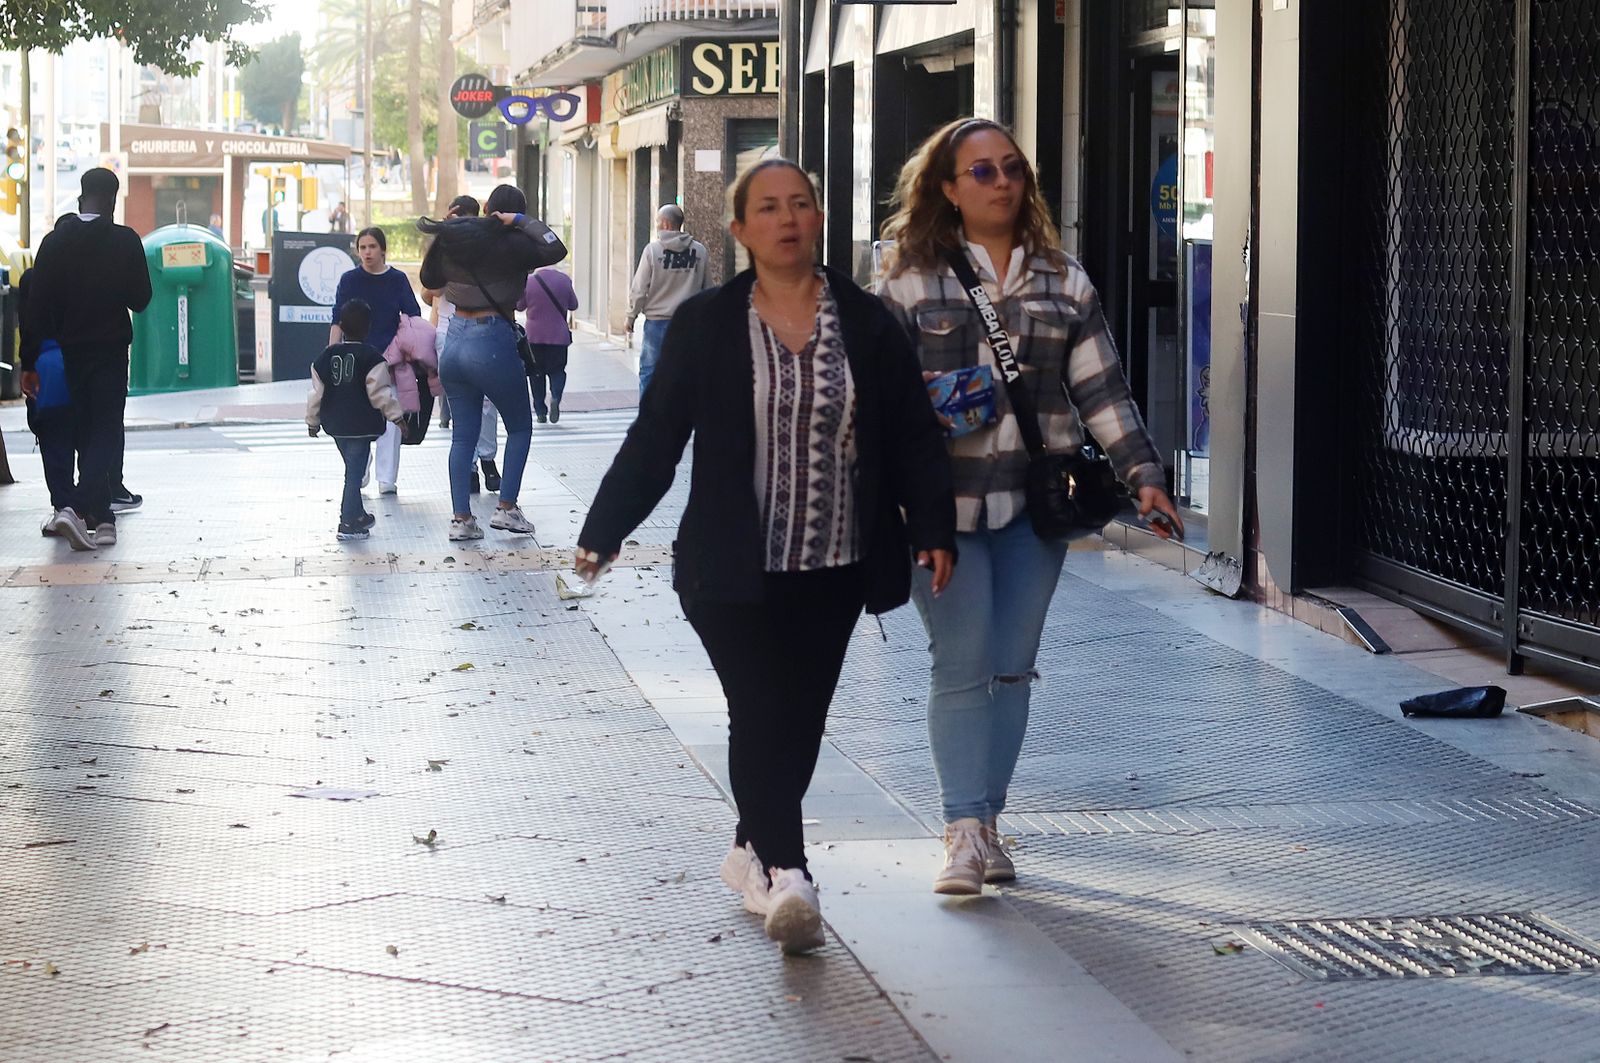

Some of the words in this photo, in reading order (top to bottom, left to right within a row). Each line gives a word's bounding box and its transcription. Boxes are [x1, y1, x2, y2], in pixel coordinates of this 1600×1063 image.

[453, 90, 493, 102] JOKER
[131, 140, 197, 153] CHURRERIA
[205, 140, 214, 153] Y
[221, 141, 309, 156] CHOCOLATERIA
[477, 129, 498, 151] C
[969, 285, 1000, 333] BIMBA
[991, 339, 1020, 383] LOLA
[330, 353, 355, 386] 90
